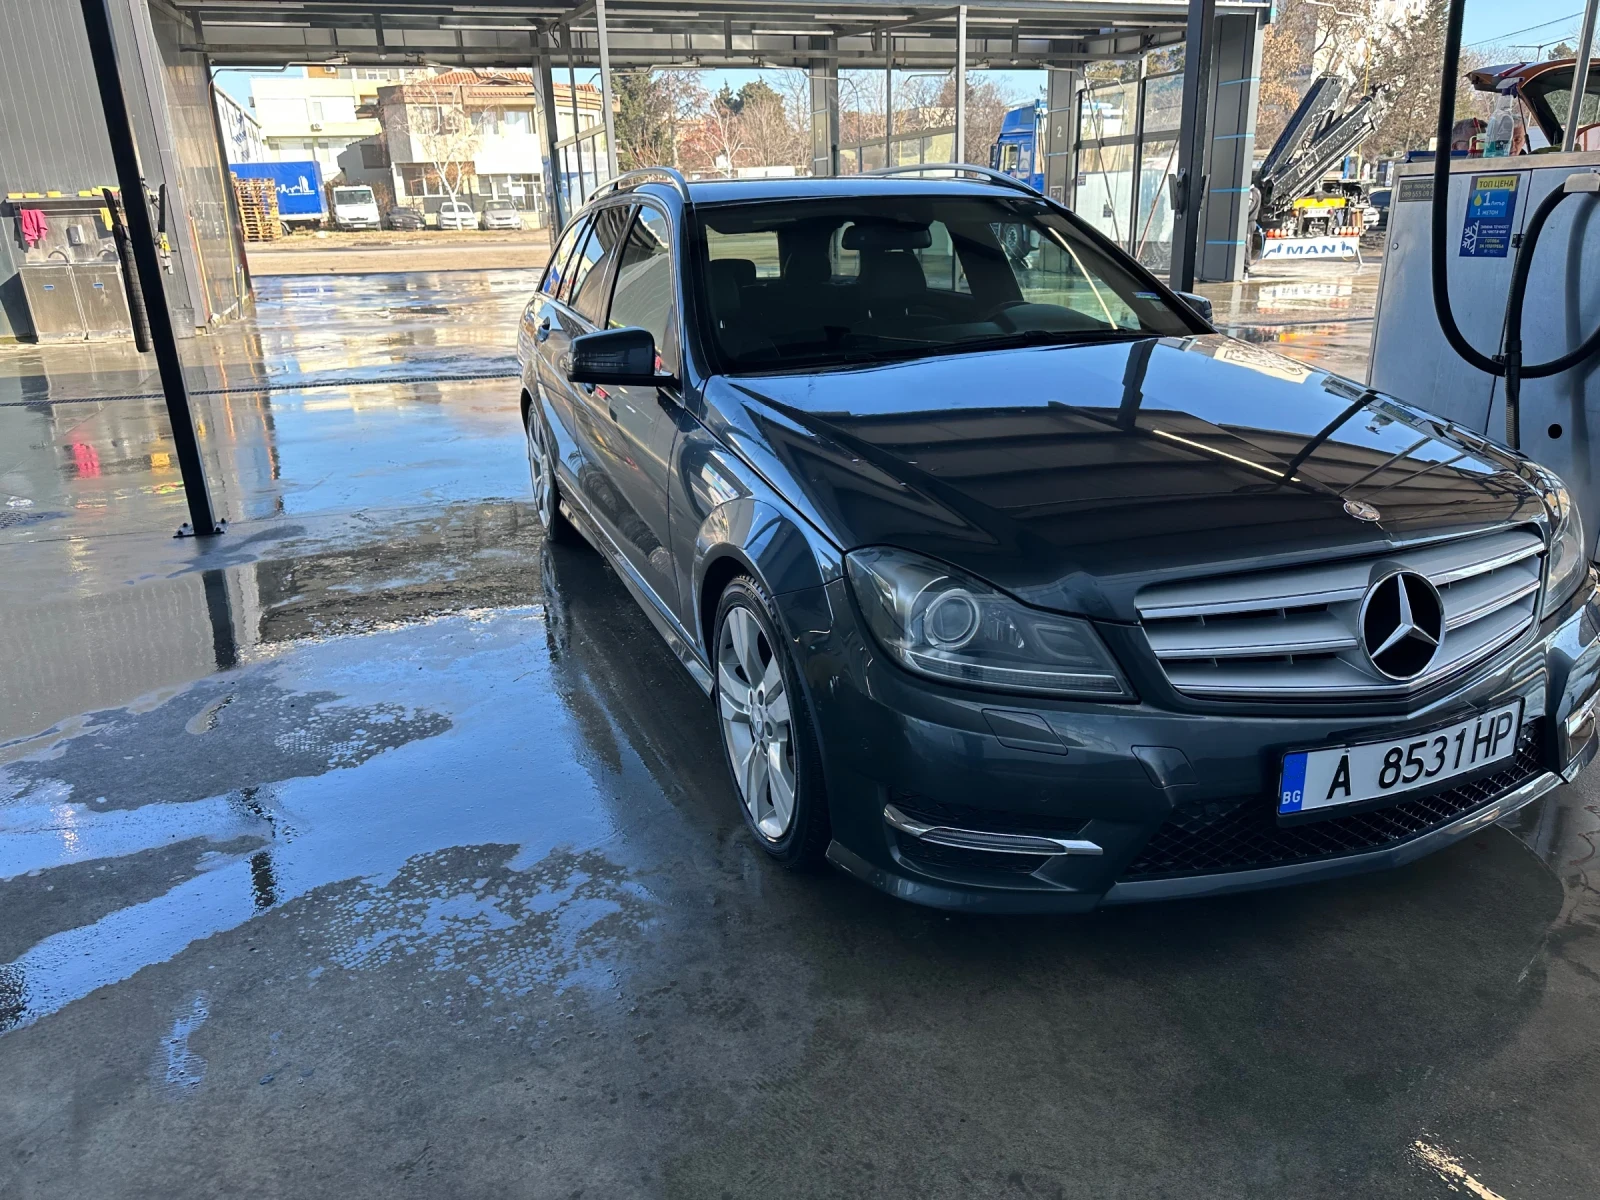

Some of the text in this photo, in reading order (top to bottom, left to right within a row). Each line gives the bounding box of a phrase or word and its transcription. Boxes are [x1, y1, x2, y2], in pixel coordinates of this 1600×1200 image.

[1057, 126, 1062, 138] 2
[1494, 180, 1514, 188] ЦЕНА
[1483, 191, 1491, 206] 1
[1477, 208, 1481, 216] 1
[1286, 244, 1336, 255] MAN
[1325, 754, 1352, 801] A
[1282, 789, 1301, 806] BG
